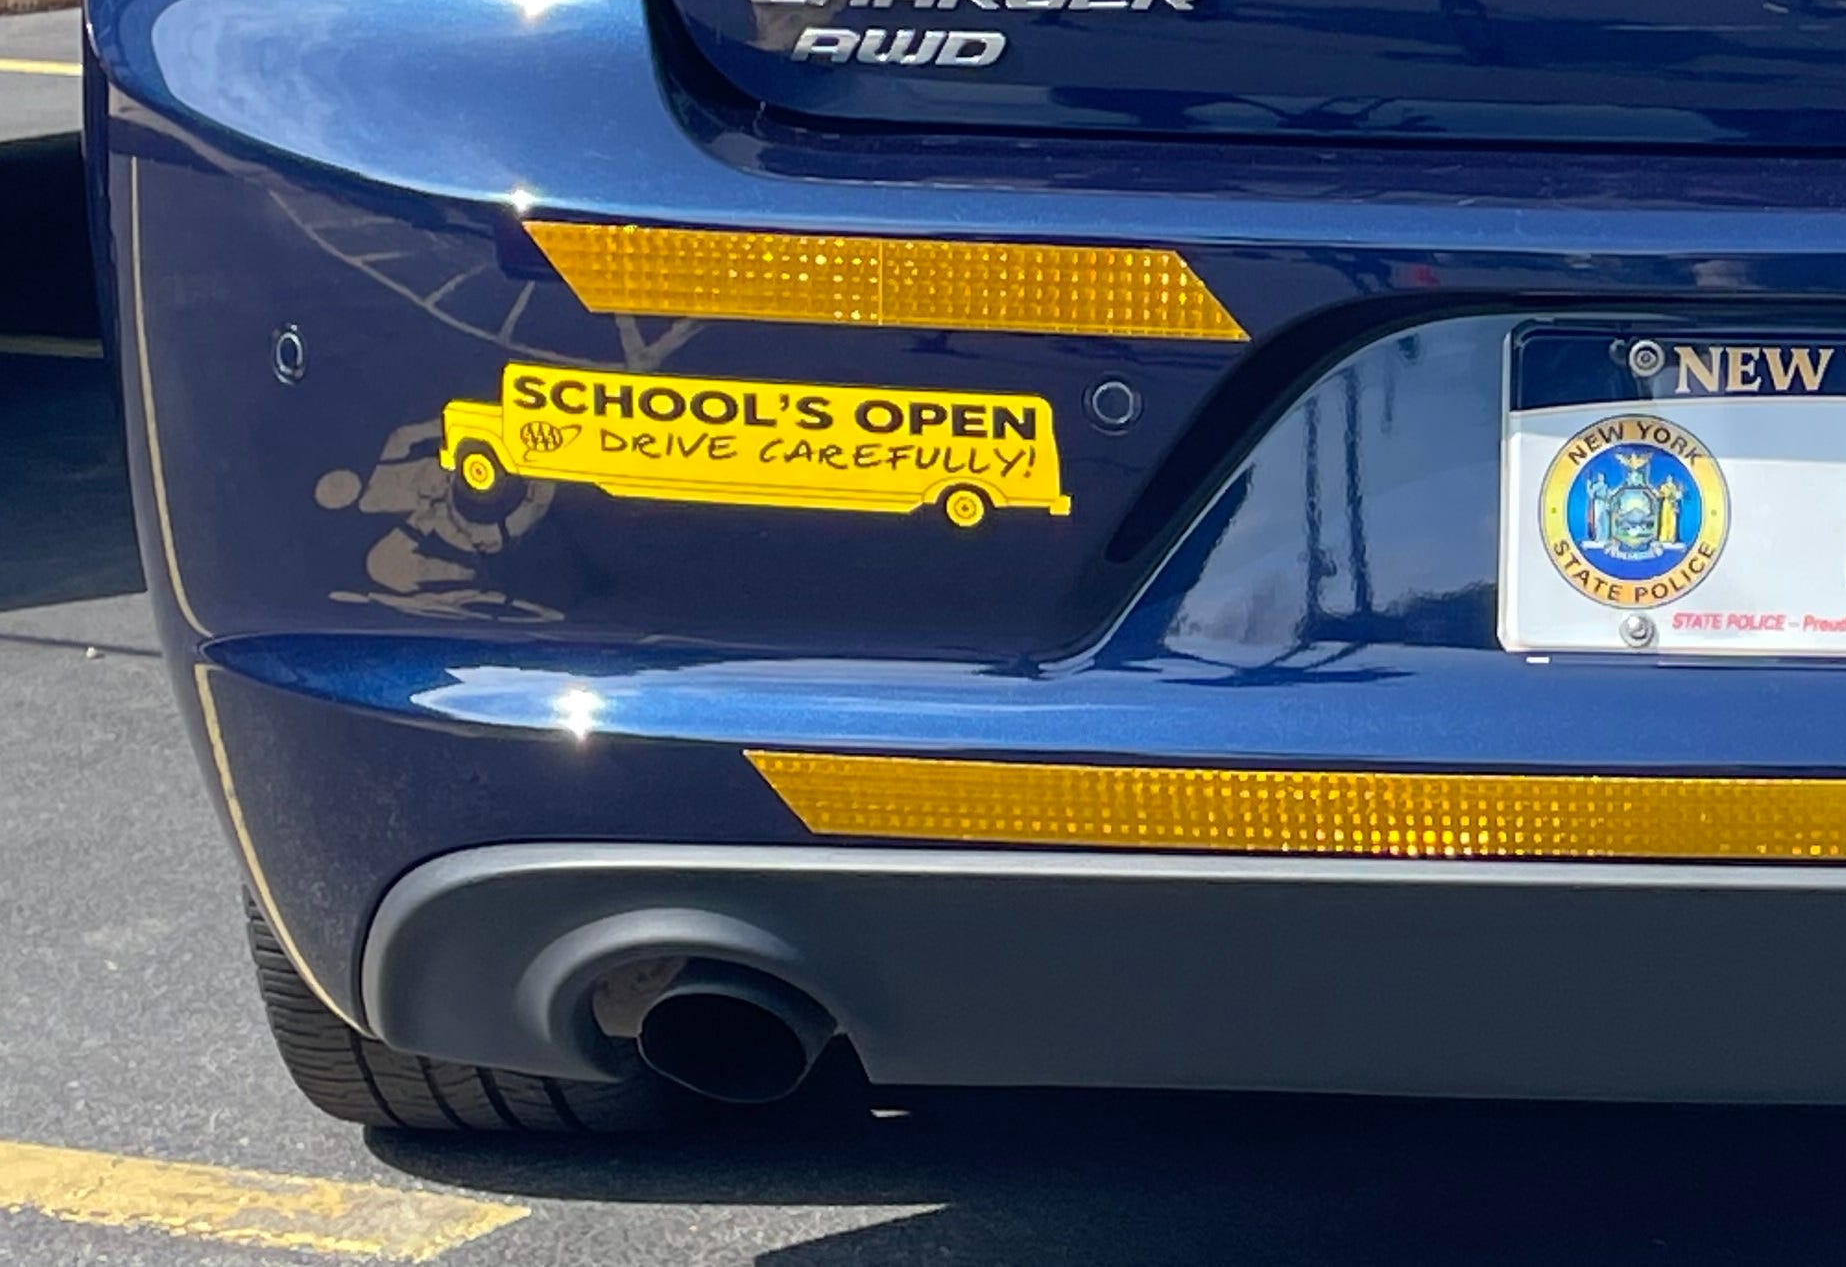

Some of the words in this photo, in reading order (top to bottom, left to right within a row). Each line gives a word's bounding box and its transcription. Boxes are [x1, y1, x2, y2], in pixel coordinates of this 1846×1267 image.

[790, 27, 1007, 66] AWD
[1674, 345, 1831, 395] NEW
[513, 375, 834, 431] SCHOOL'S
[854, 399, 1037, 441] OPEN
[600, 428, 739, 460] DRIVE
[758, 438, 1037, 478] CAREFULLY!
[1568, 422, 1625, 466] NEW
[1636, 420, 1703, 466] YORK
[1553, 539, 1624, 602] STATE
[1634, 541, 1716, 603] POLICE
[1671, 612, 1723, 631] STATE
[1725, 613, 1786, 631] POLICE
